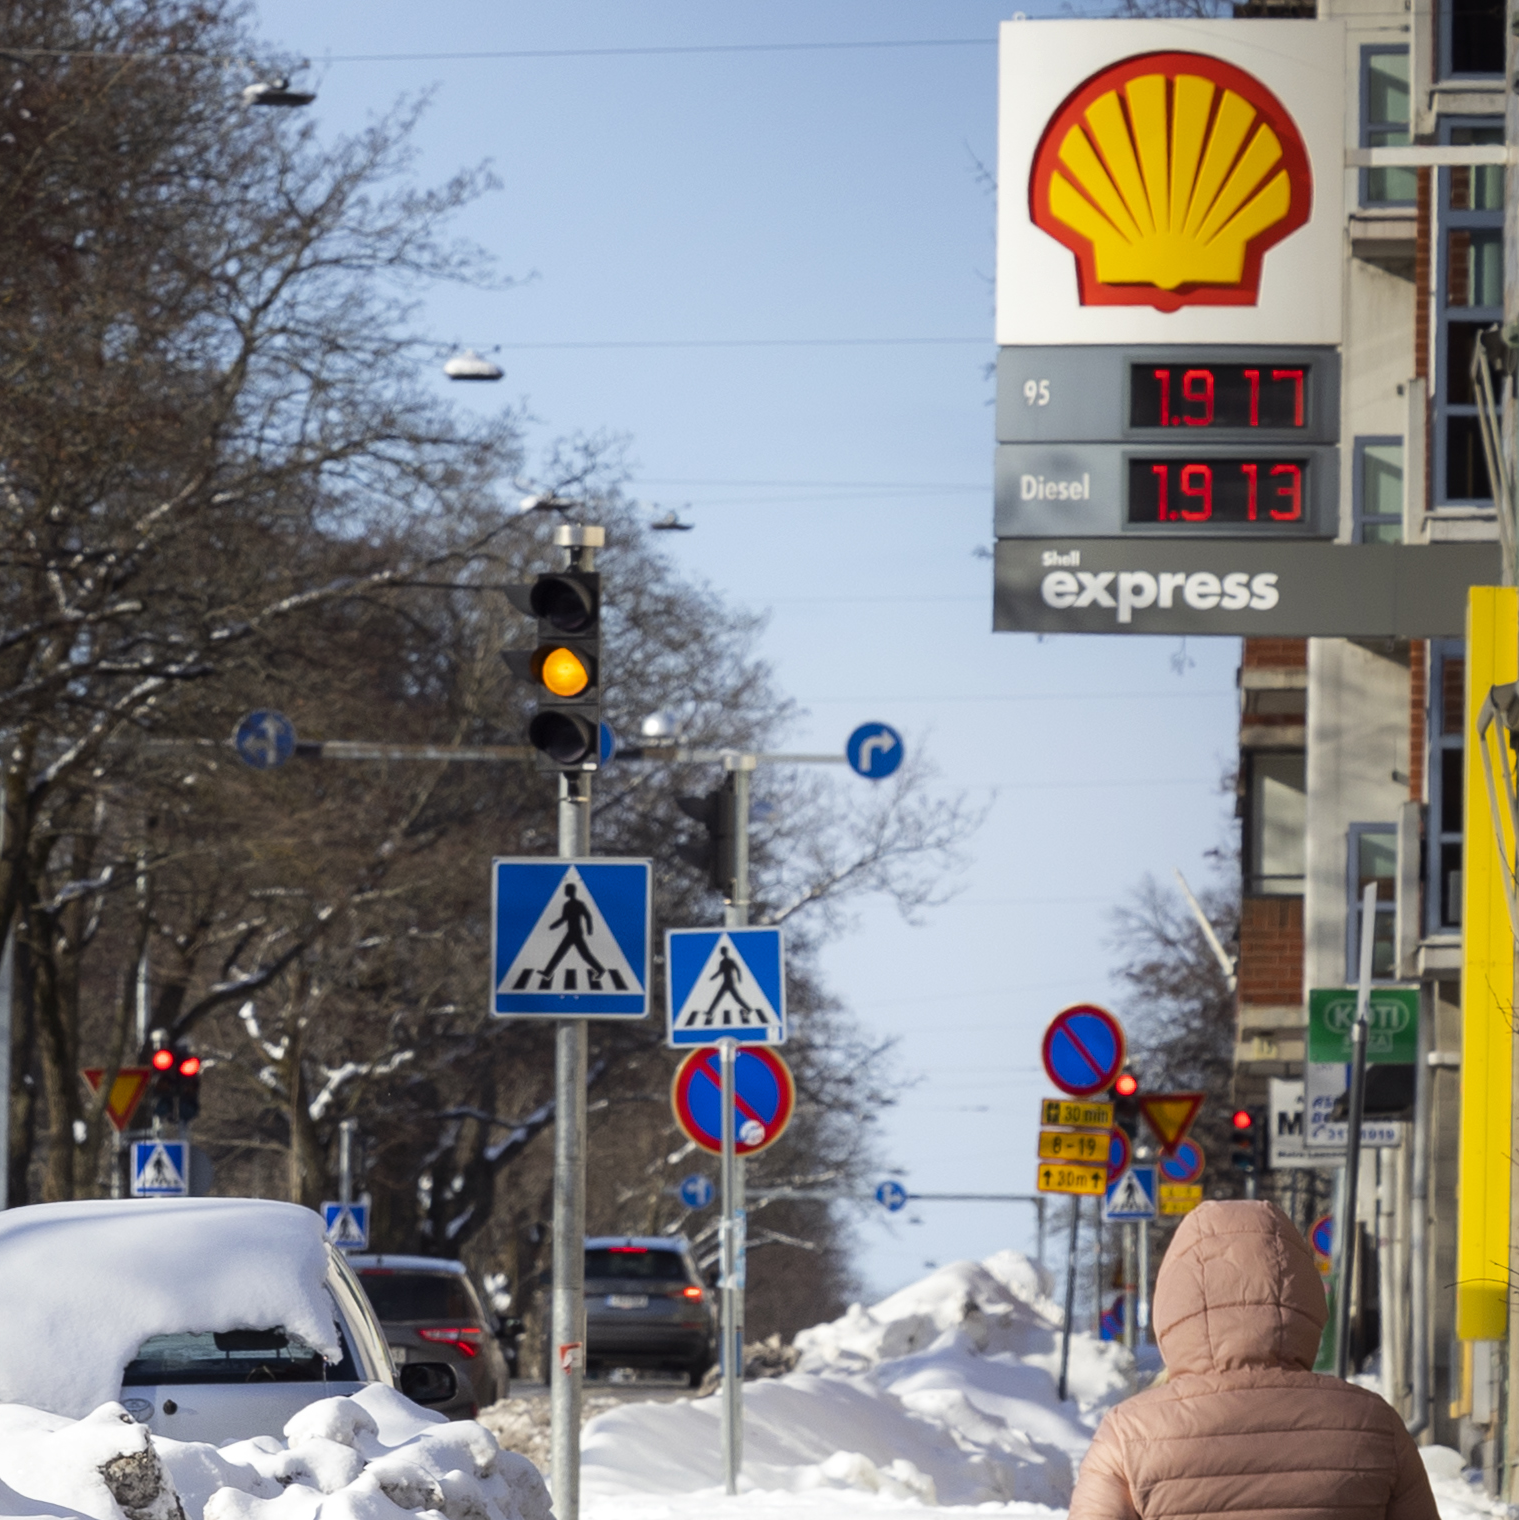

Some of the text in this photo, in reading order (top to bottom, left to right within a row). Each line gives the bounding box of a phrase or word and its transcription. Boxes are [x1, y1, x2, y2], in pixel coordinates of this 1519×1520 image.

[1023, 369, 1304, 427] 95 1.917
[1020, 463, 1302, 522] Diesel 1.913
[1041, 551, 1080, 567] Shell
[1041, 570, 1279, 623] express
[1064, 1106, 1081, 1122] 30
